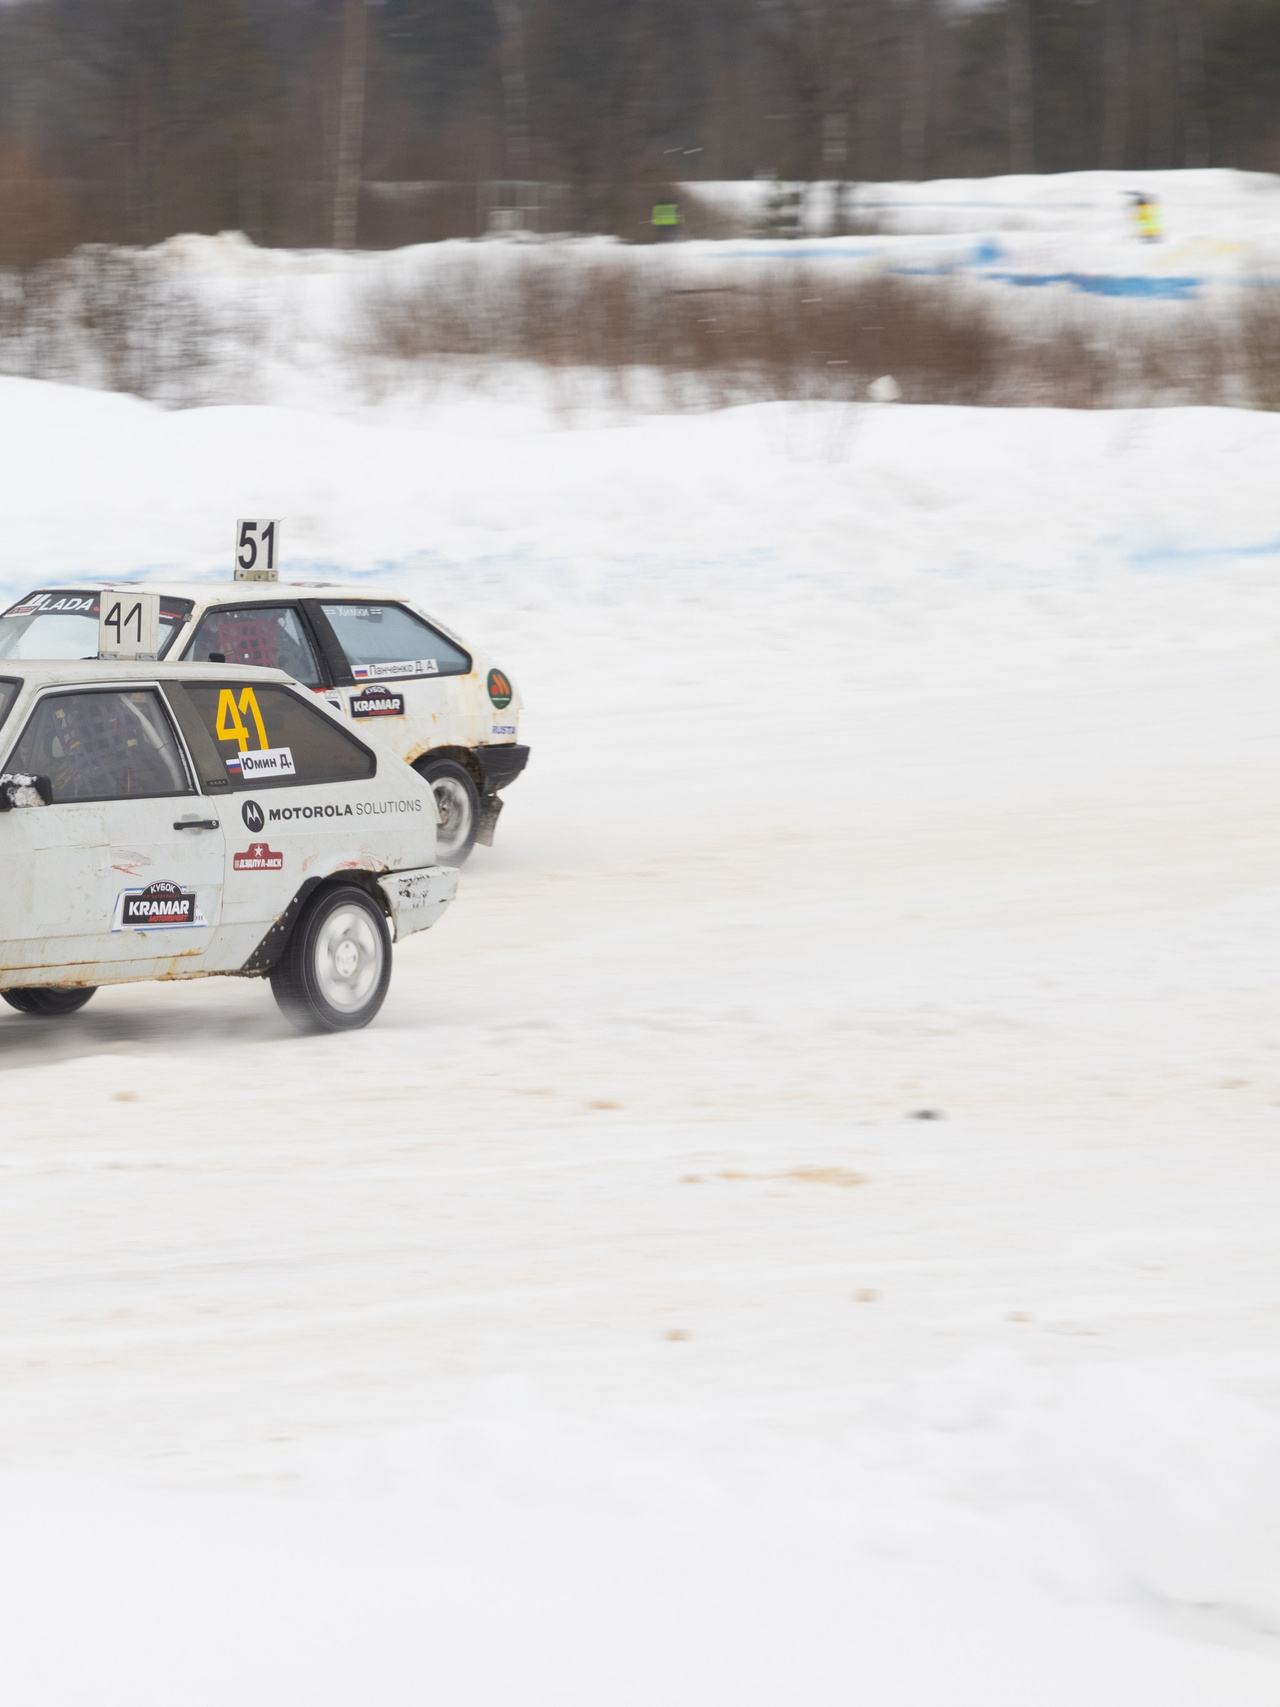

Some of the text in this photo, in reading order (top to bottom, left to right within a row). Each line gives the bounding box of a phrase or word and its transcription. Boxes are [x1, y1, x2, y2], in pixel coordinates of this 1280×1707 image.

[238, 521, 275, 570] 51
[37, 598, 95, 612] LADA
[336, 606, 370, 617] Химки
[104, 602, 142, 644] 41
[370, 664, 414, 676] Панченко
[353, 698, 401, 712] KRAMAR
[215, 687, 270, 752] 41
[241, 754, 292, 770] Юмин Д.
[269, 799, 422, 821] MOTOROLA SOLUTIONS
[150, 882, 176, 894] КУБОК
[128, 899, 190, 916] KRAMAR
